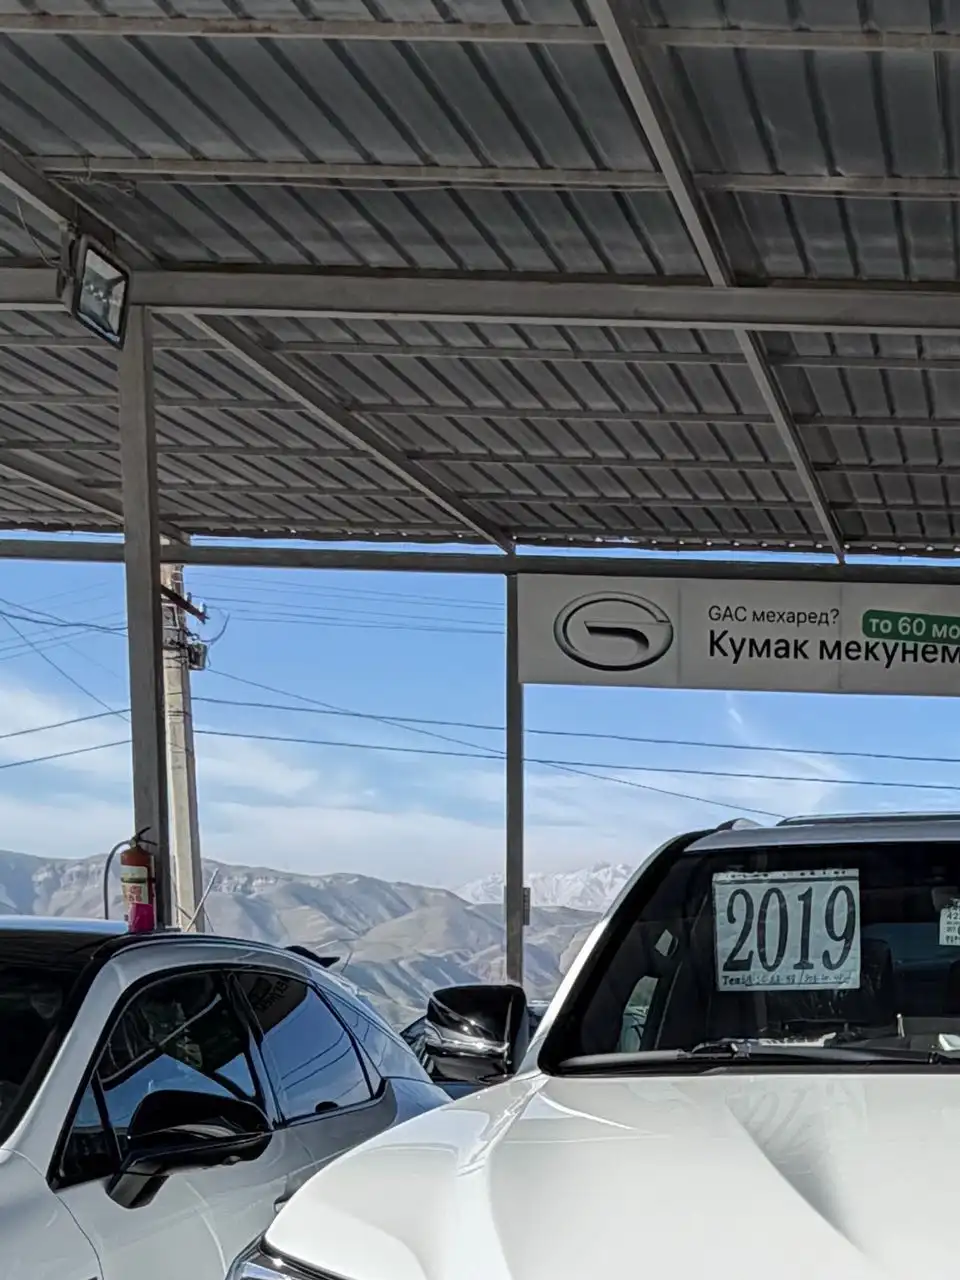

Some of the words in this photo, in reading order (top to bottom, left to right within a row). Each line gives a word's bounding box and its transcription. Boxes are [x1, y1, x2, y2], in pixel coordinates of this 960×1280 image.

[708, 605, 747, 622] GAC
[752, 608, 840, 628] мехаред?
[869, 618, 892, 633] то
[898, 616, 926, 636] 60
[709, 629, 810, 665] Кумак
[722, 885, 856, 972] 2019
